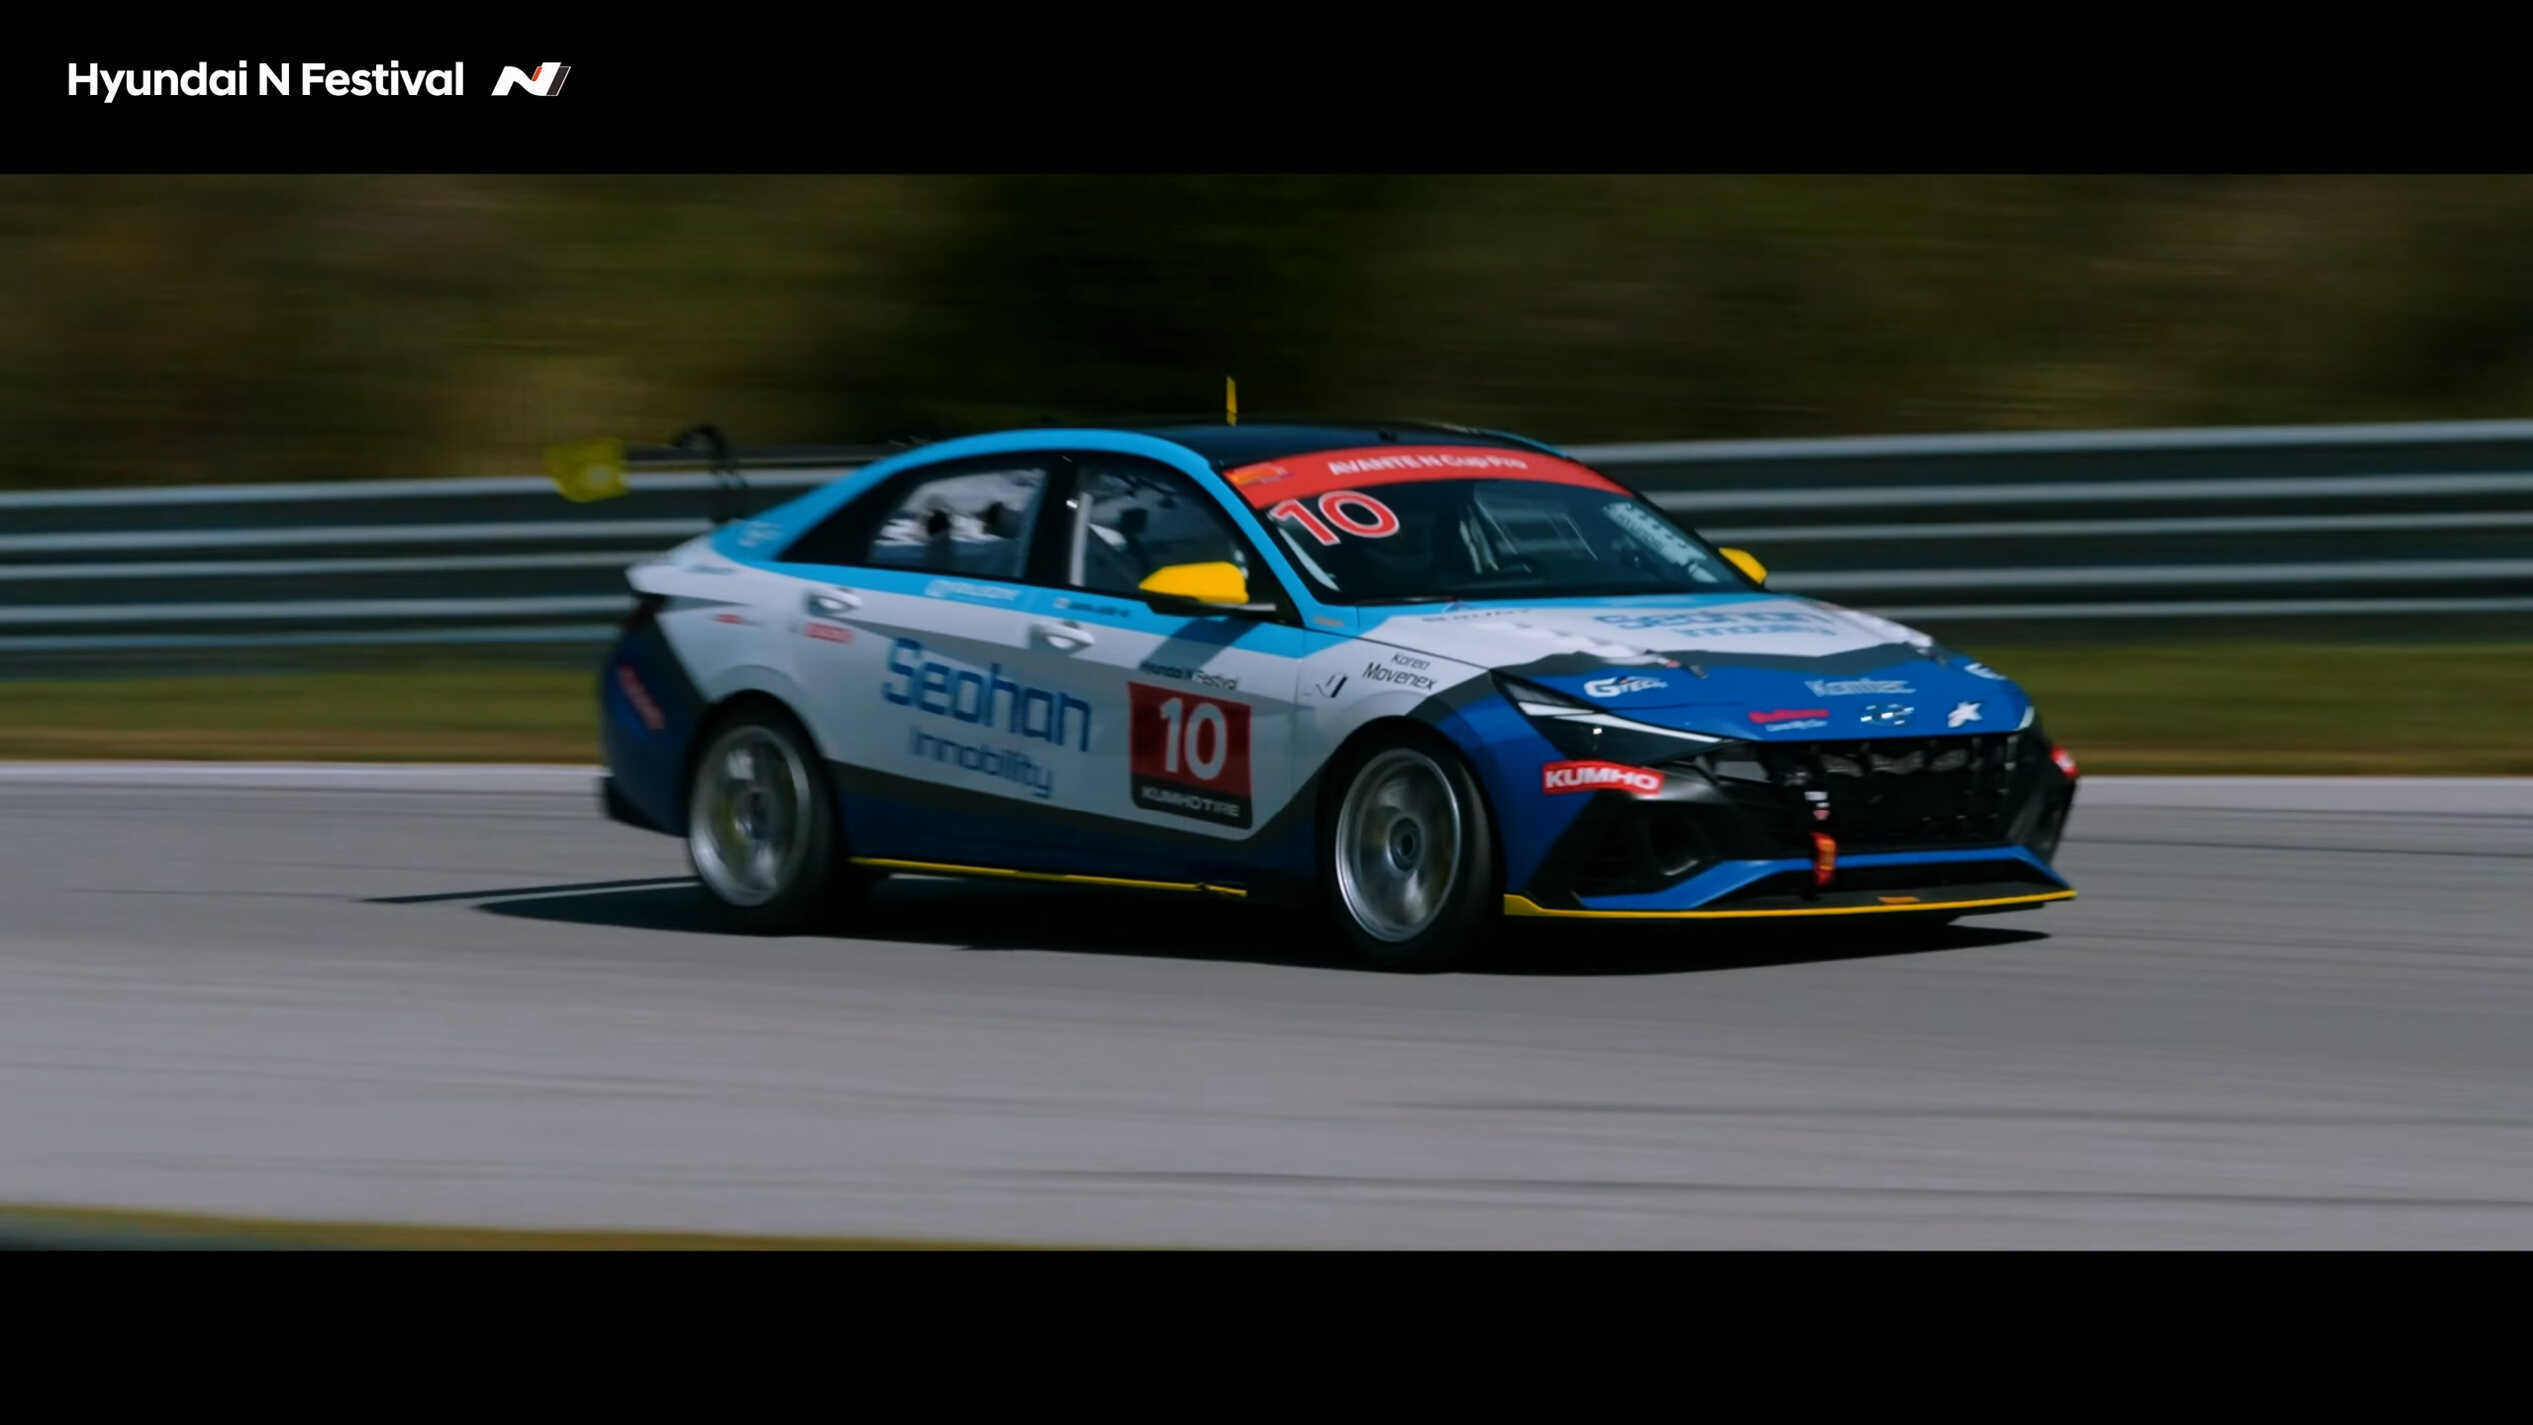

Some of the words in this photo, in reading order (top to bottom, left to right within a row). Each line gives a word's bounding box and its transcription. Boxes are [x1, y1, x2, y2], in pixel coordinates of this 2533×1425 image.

[1328, 454, 1420, 476] AVANTE
[1441, 454, 1487, 470] Cup
[1486, 454, 1528, 471] Pro
[1268, 489, 1401, 547] 10
[1362, 661, 1438, 691] Movenex
[1391, 653, 1431, 671] Korea
[1159, 696, 1229, 782] 10
[1544, 767, 1661, 794] KUMHO
